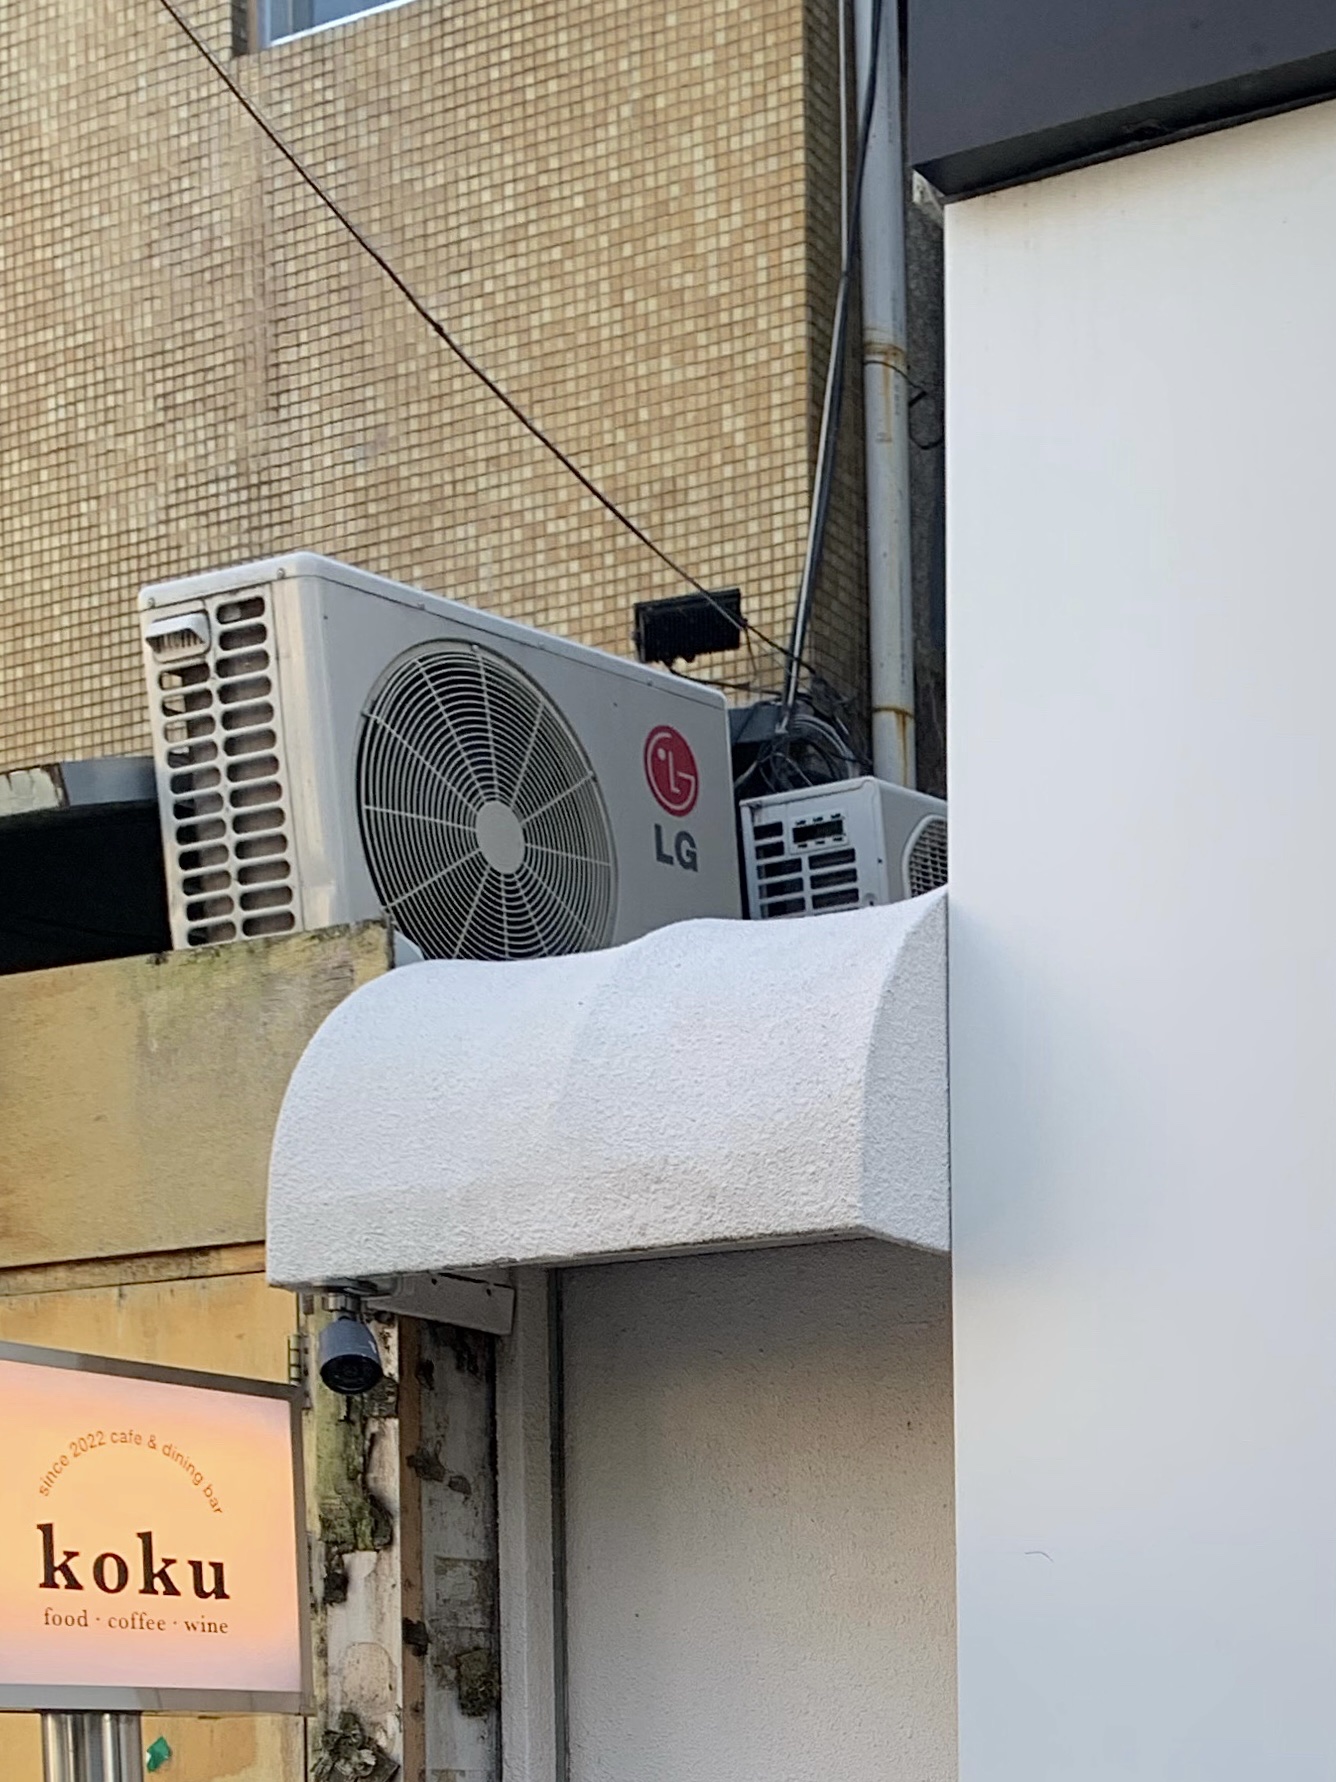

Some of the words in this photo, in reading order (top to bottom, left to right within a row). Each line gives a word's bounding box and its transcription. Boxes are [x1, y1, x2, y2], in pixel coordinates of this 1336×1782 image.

[654, 823, 698, 872] LG
[38, 1455, 69, 1497] since
[68, 1429, 108, 1459] 2022
[109, 1428, 143, 1447] cafe
[146, 1434, 158, 1451] &
[161, 1443, 205, 1487] dining
[202, 1483, 224, 1515] bar
[36, 1522, 230, 1600] koku
[42, 1607, 90, 1628] food
[107, 1612, 167, 1632] coffee
[183, 1614, 229, 1635] wine
